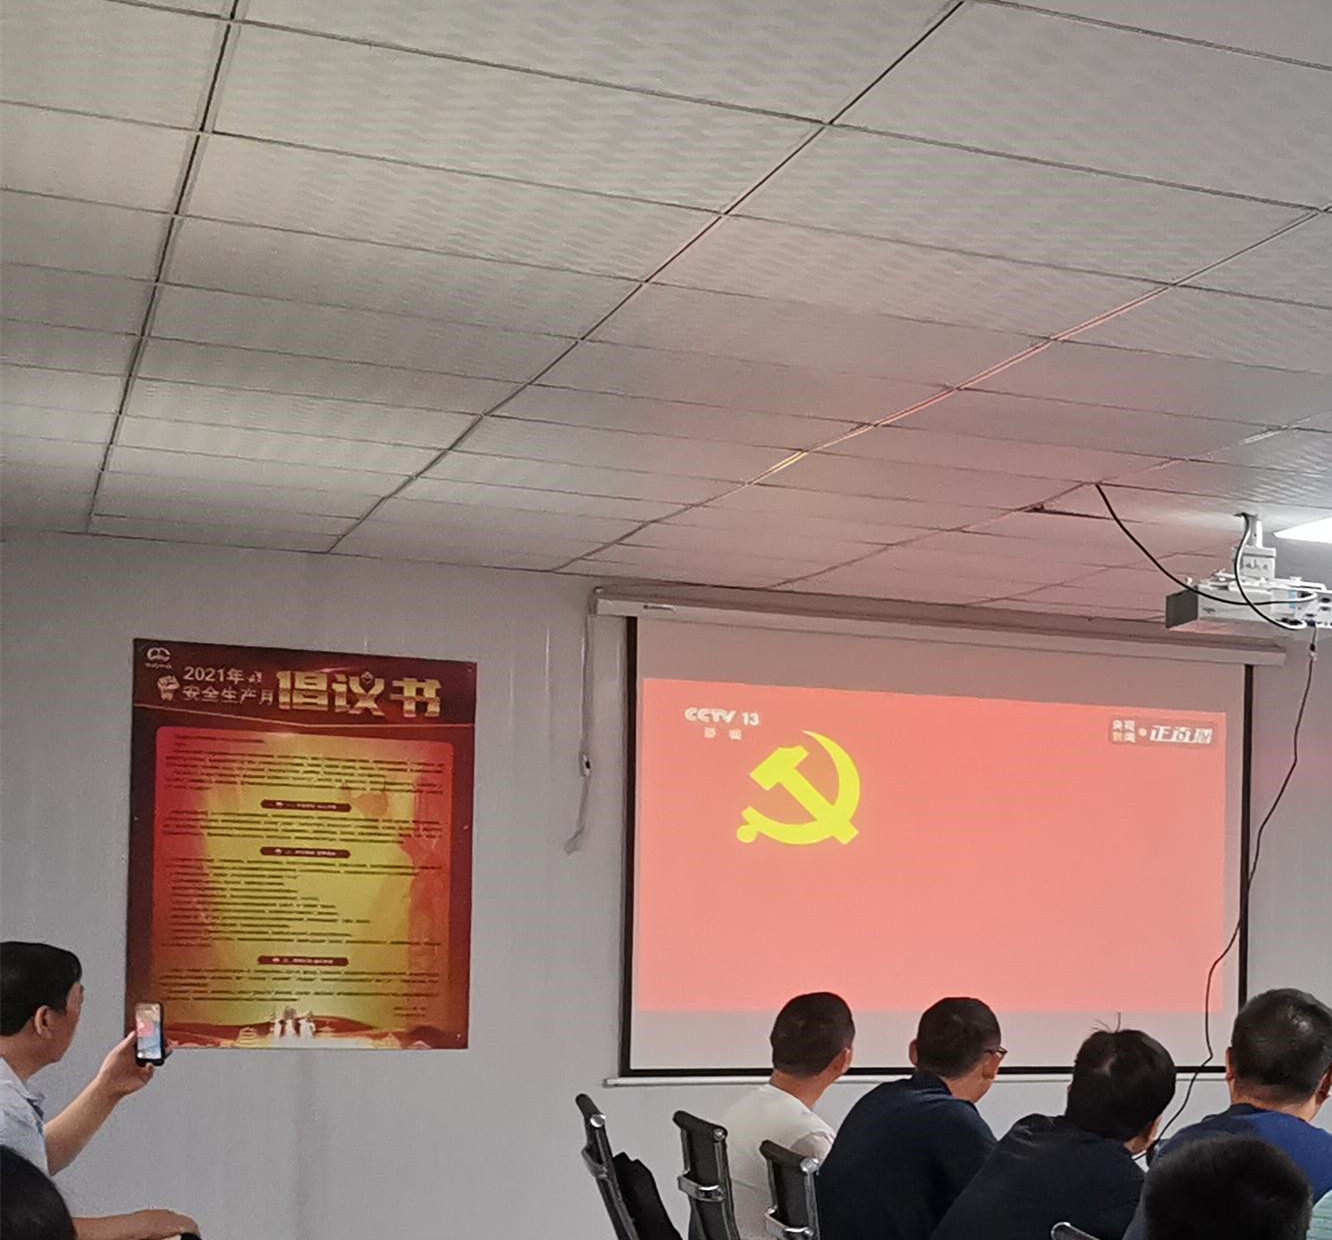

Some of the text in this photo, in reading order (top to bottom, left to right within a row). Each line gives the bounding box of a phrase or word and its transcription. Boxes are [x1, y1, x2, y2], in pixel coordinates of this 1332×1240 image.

[183, 666, 244, 684] 2021年
[182, 685, 274, 705] 安全生产月
[276, 670, 441, 718] 倡议书
[684, 706, 760, 726] CCTV 13
